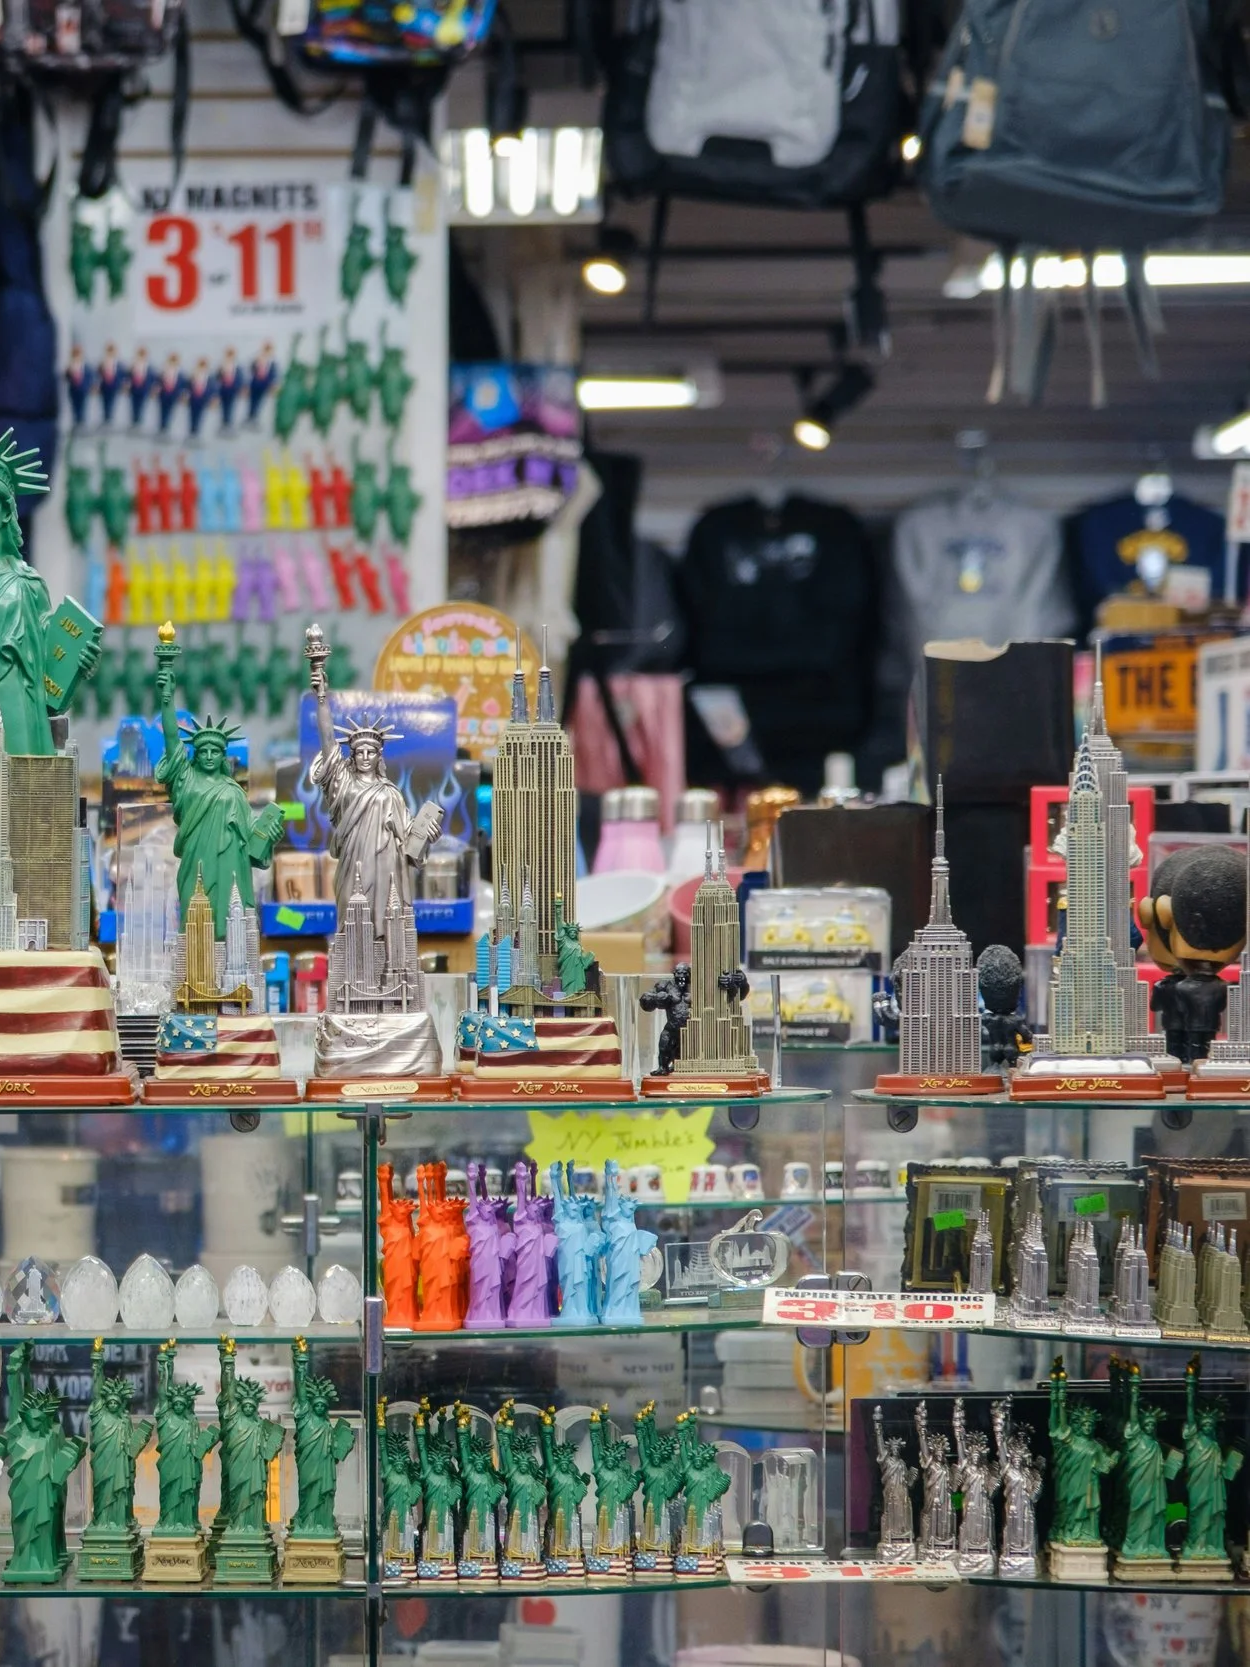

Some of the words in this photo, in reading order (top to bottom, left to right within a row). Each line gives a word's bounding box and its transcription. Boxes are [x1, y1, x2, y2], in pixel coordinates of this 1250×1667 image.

[186, 184, 319, 211] MAGNETS
[145, 215, 201, 313] 3
[1118, 661, 1176, 711] THE
[774, 1289, 839, 1299] EMPIRE
[843, 1293, 897, 1301] STATE
[900, 1294, 985, 1302] BUILDING
[776, 1299, 840, 1322] 3
[743, 1564, 812, 1579] 3
